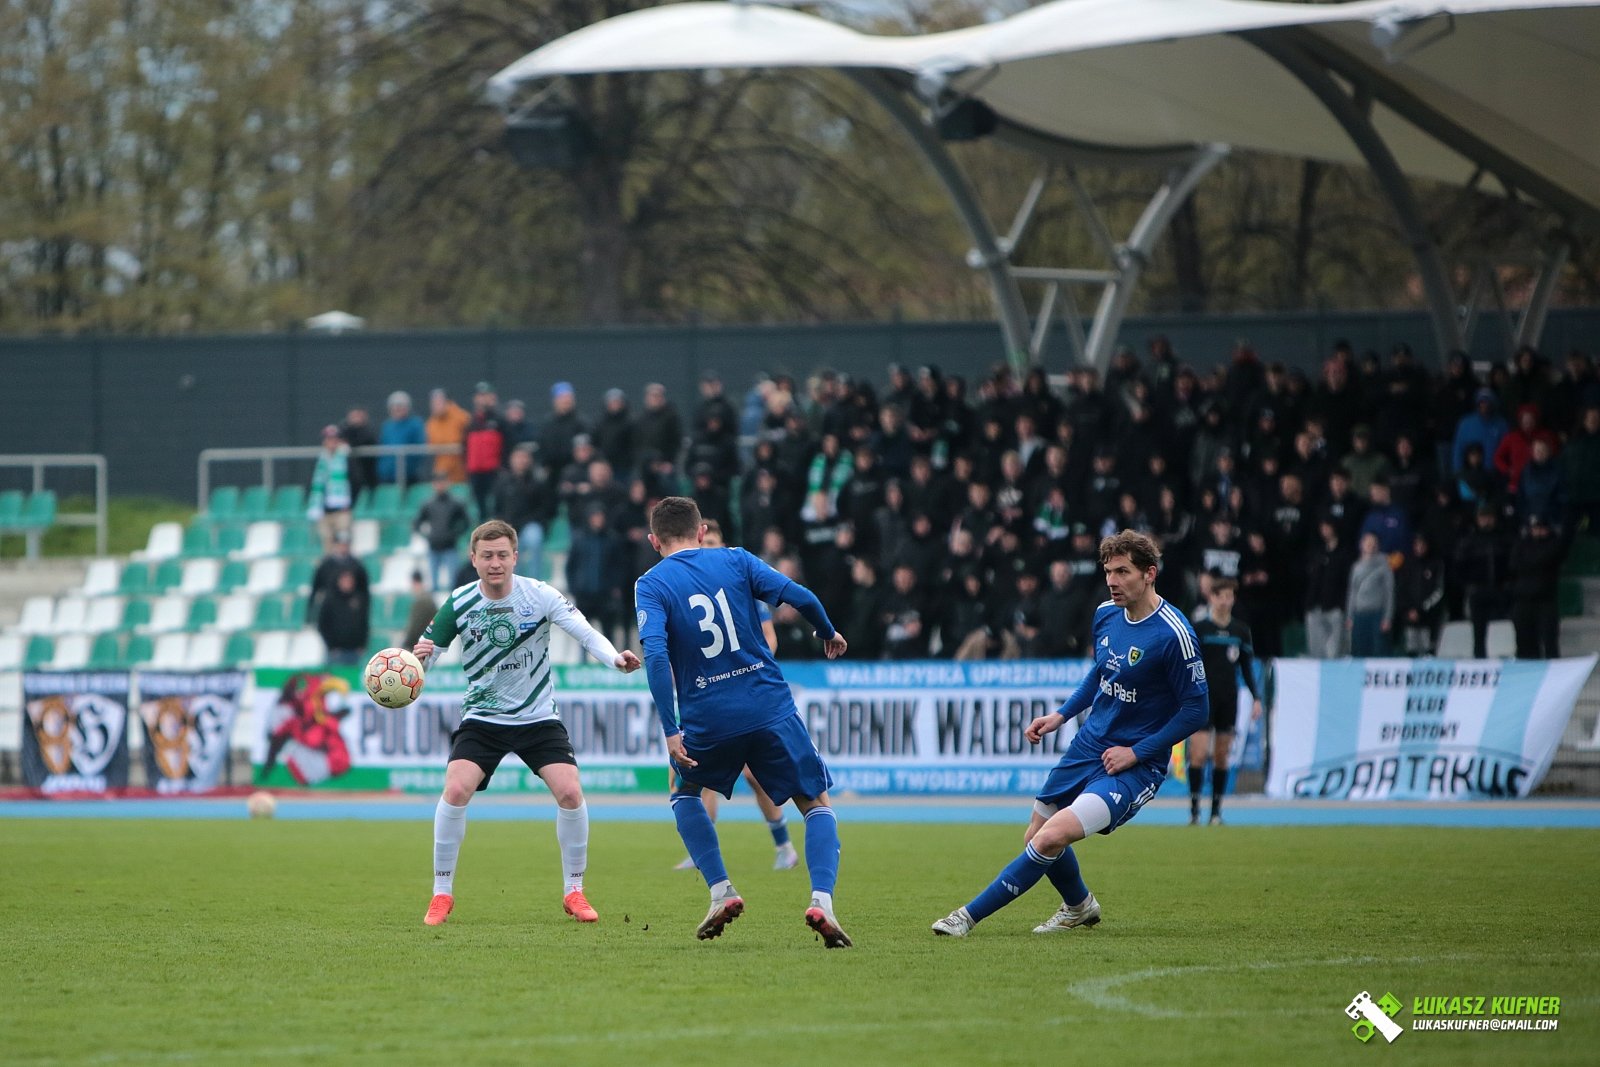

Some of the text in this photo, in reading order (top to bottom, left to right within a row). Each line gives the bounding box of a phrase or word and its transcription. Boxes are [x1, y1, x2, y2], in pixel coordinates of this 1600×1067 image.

[688, 587, 741, 659] 31
[708, 672, 731, 684] TERMY
[1113, 682, 1137, 703] Plast
[807, 690, 918, 756] GÓRNIK
